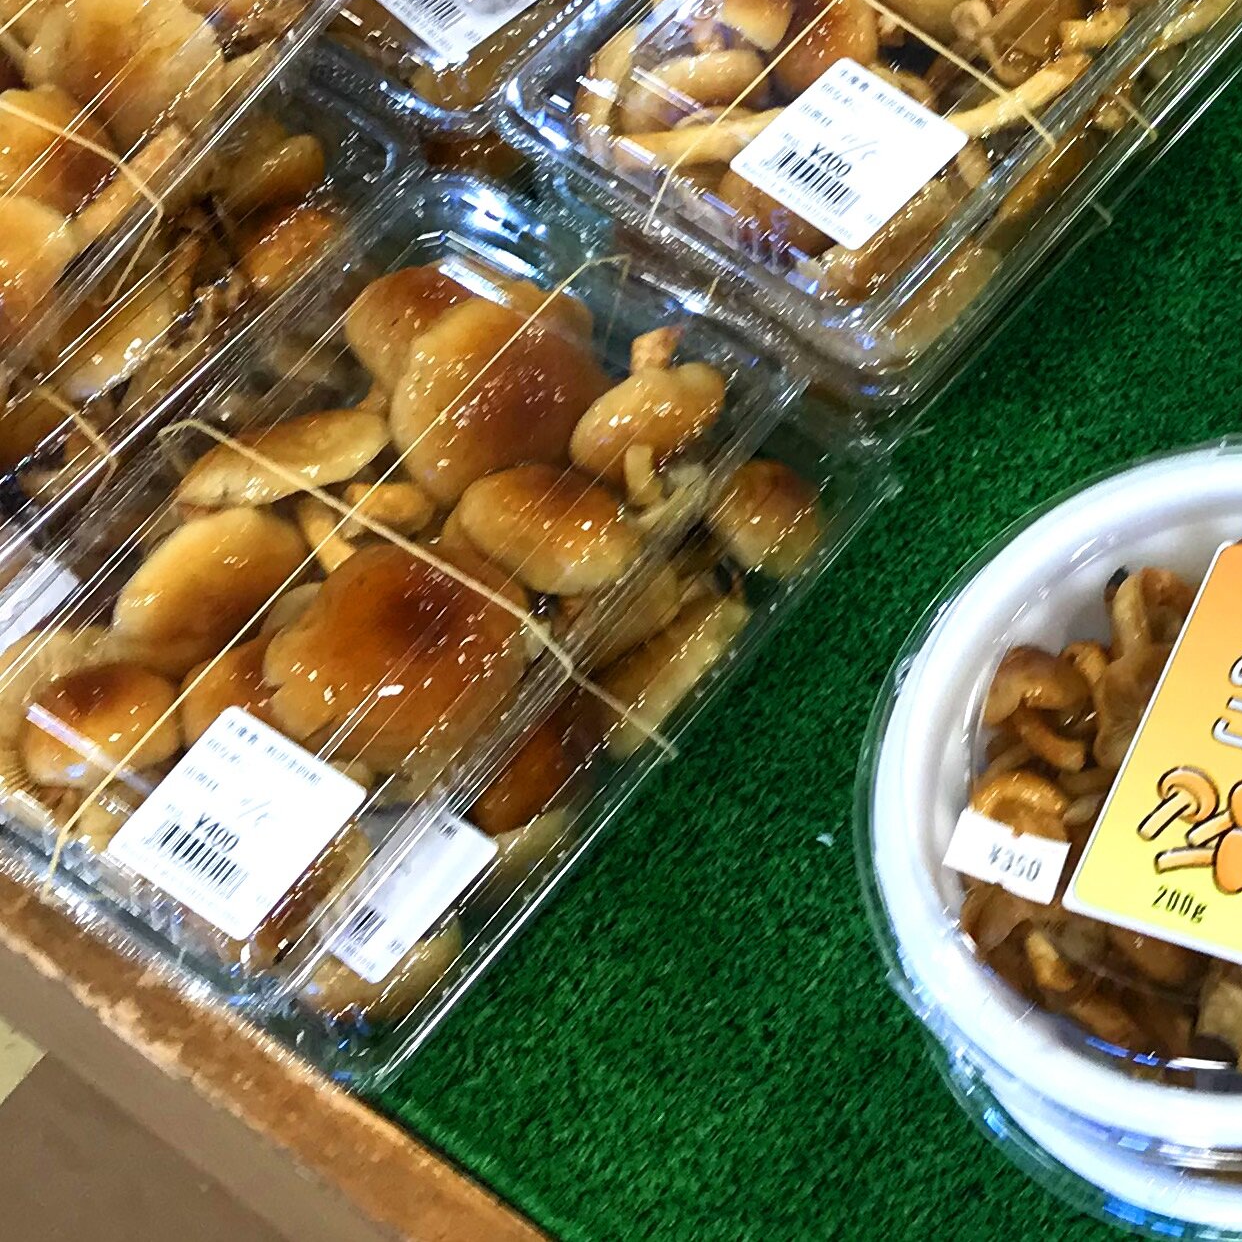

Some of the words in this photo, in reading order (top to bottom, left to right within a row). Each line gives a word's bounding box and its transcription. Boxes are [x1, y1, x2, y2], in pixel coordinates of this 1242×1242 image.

[804, 141, 855, 180] ¥400
[188, 811, 243, 855] ¥400
[987, 843, 1043, 882] ¥350
[1151, 885, 1207, 923] 200g
